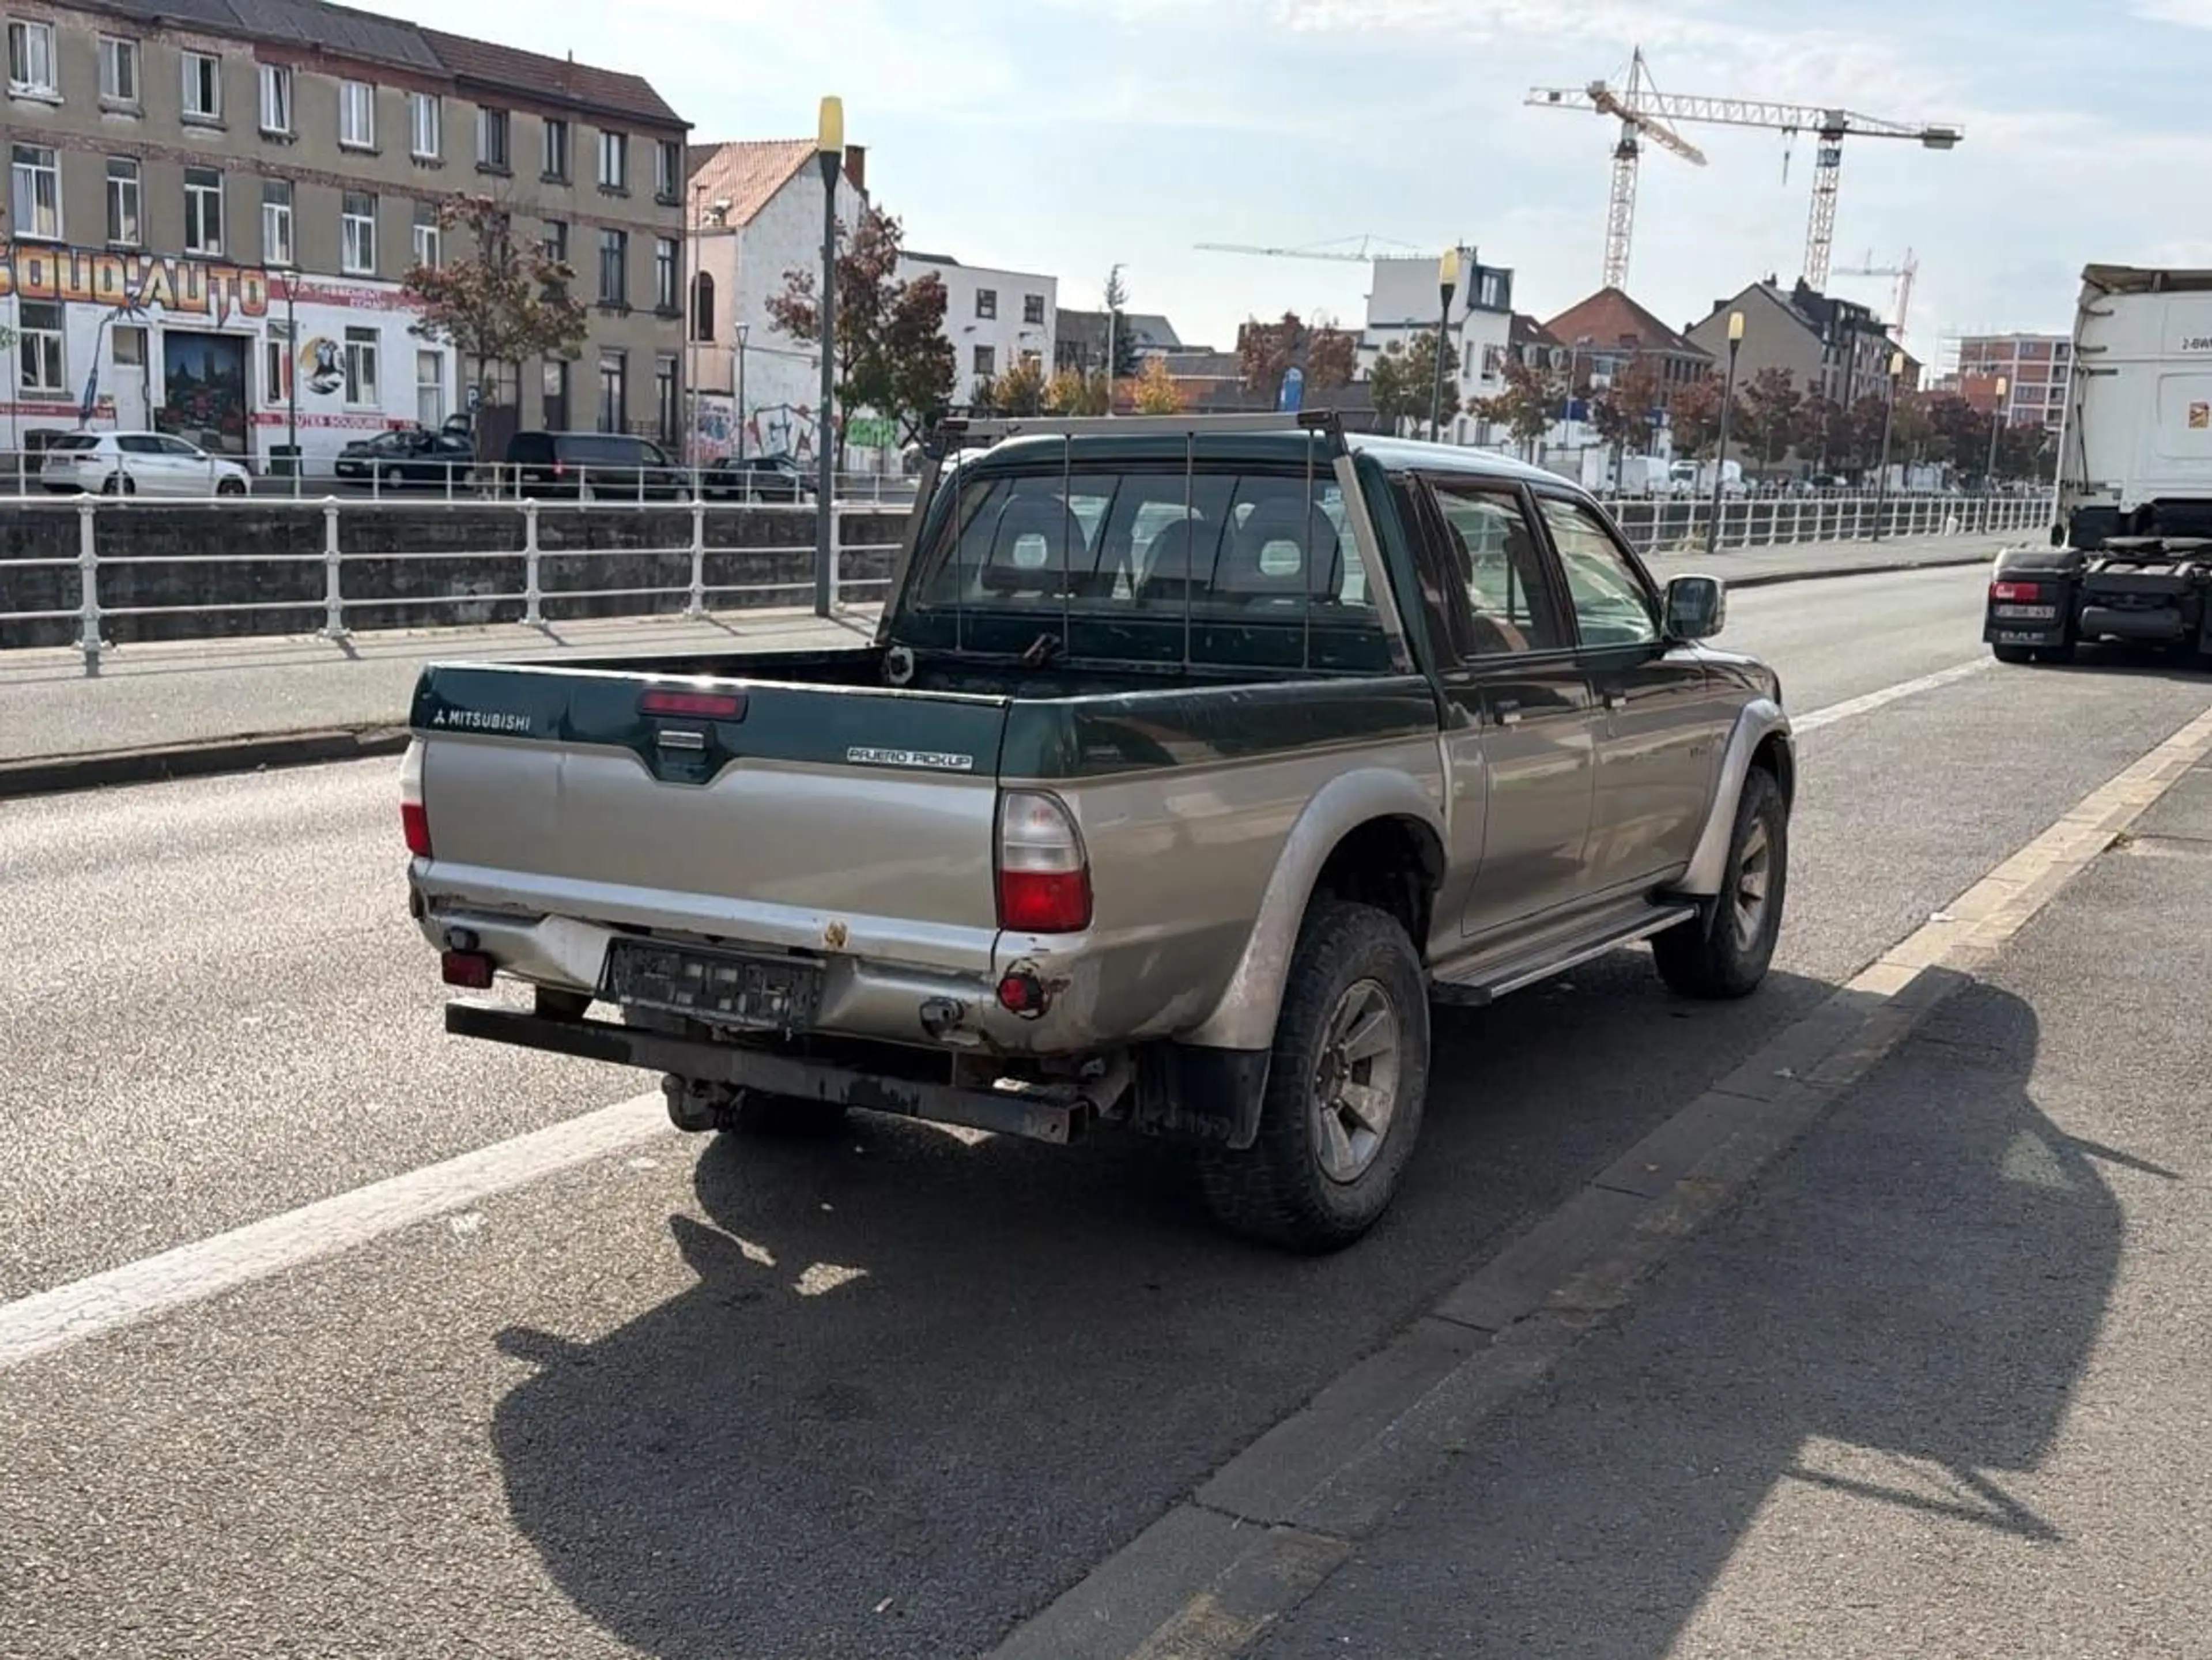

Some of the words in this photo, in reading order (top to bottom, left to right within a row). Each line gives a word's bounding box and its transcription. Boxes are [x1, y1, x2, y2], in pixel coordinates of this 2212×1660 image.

[468, 388, 479, 406] P
[448, 710, 531, 732] MITSUBISHI
[848, 748, 907, 763] PAJERO
